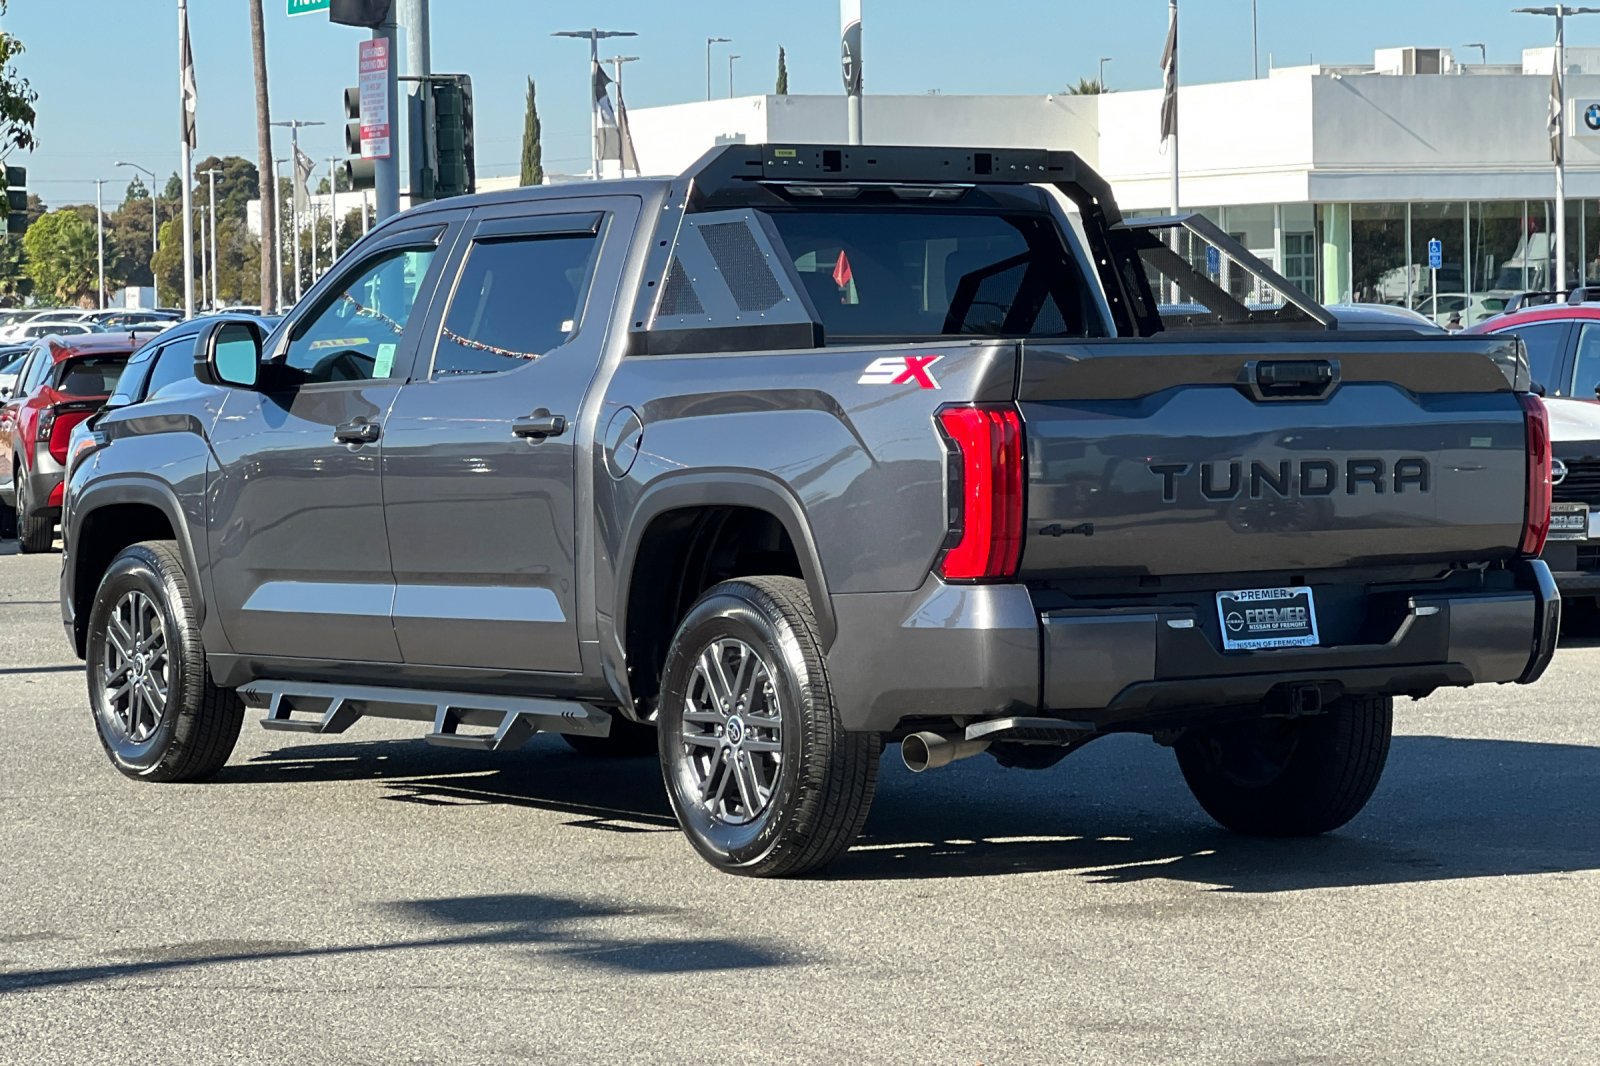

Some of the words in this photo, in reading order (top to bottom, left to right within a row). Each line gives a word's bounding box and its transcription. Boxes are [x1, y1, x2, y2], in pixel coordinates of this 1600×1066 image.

[857, 355, 945, 390] SX
[1148, 457, 1430, 502] TUNDRA
[1240, 589, 1287, 600] PREMIER
[1245, 607, 1306, 624] PREMIER
[1237, 641, 1261, 649] NISSAN
[1273, 639, 1306, 647] FREMONT
